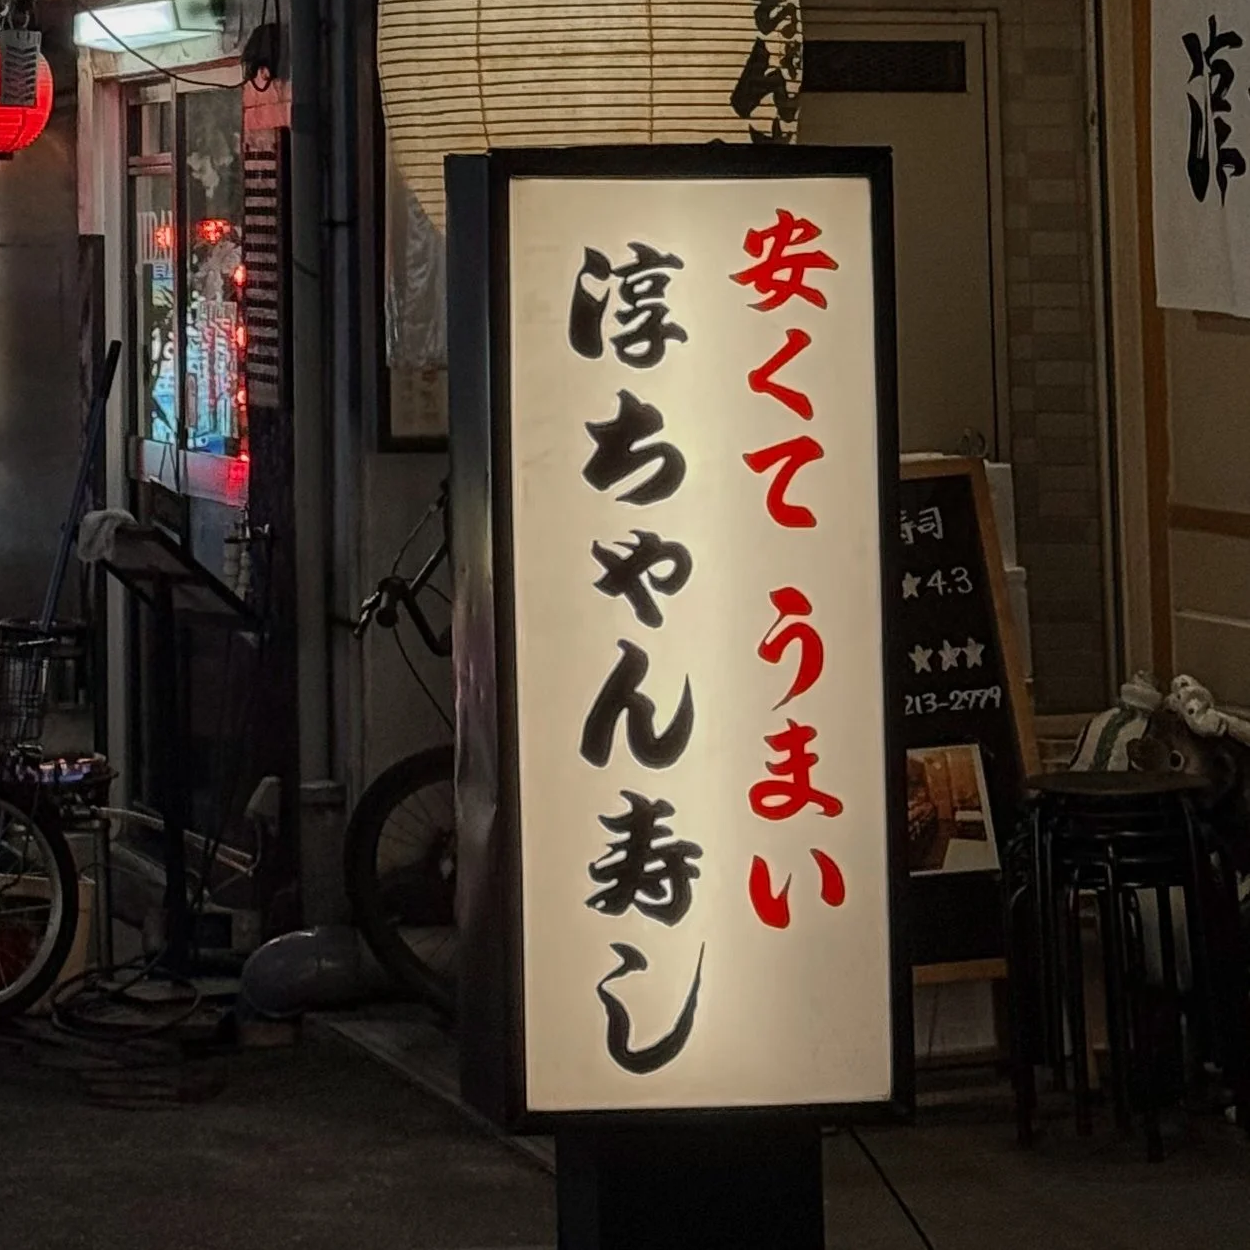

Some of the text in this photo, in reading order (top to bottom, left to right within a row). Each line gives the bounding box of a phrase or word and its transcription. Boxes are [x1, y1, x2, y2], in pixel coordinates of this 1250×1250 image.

[729, 208, 847, 931] 安くて うまい
